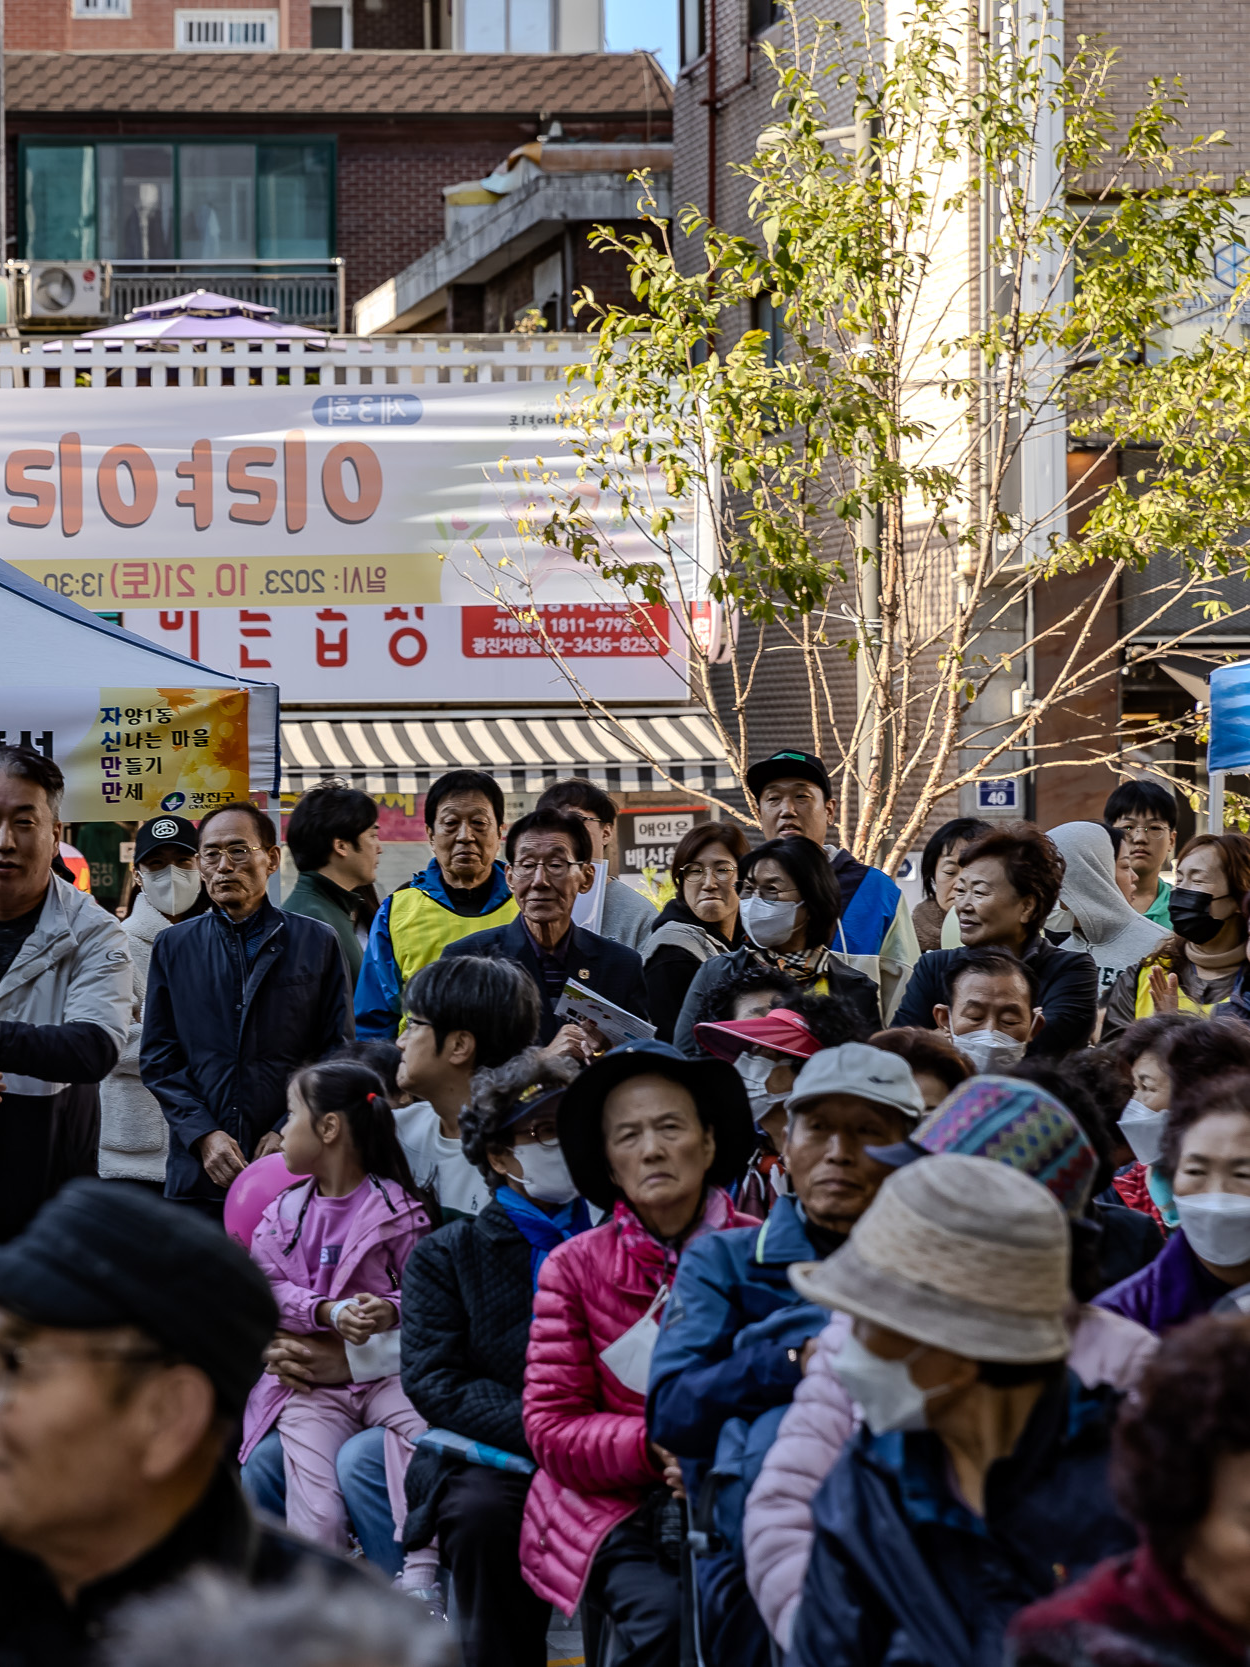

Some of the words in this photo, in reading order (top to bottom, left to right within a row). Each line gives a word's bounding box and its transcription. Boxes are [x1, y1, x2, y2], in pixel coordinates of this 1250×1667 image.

[550, 617, 633, 633] 1811-9792
[100, 706, 174, 726] 자양1동
[100, 731, 162, 753] 신나는
[171, 728, 210, 748] 마을
[101, 756, 162, 778] 만들기
[101, 782, 144, 804] 만세
[190, 791, 236, 804] 광진구
[987, 791, 1007, 806] 40
[639, 820, 690, 838] 애인은
